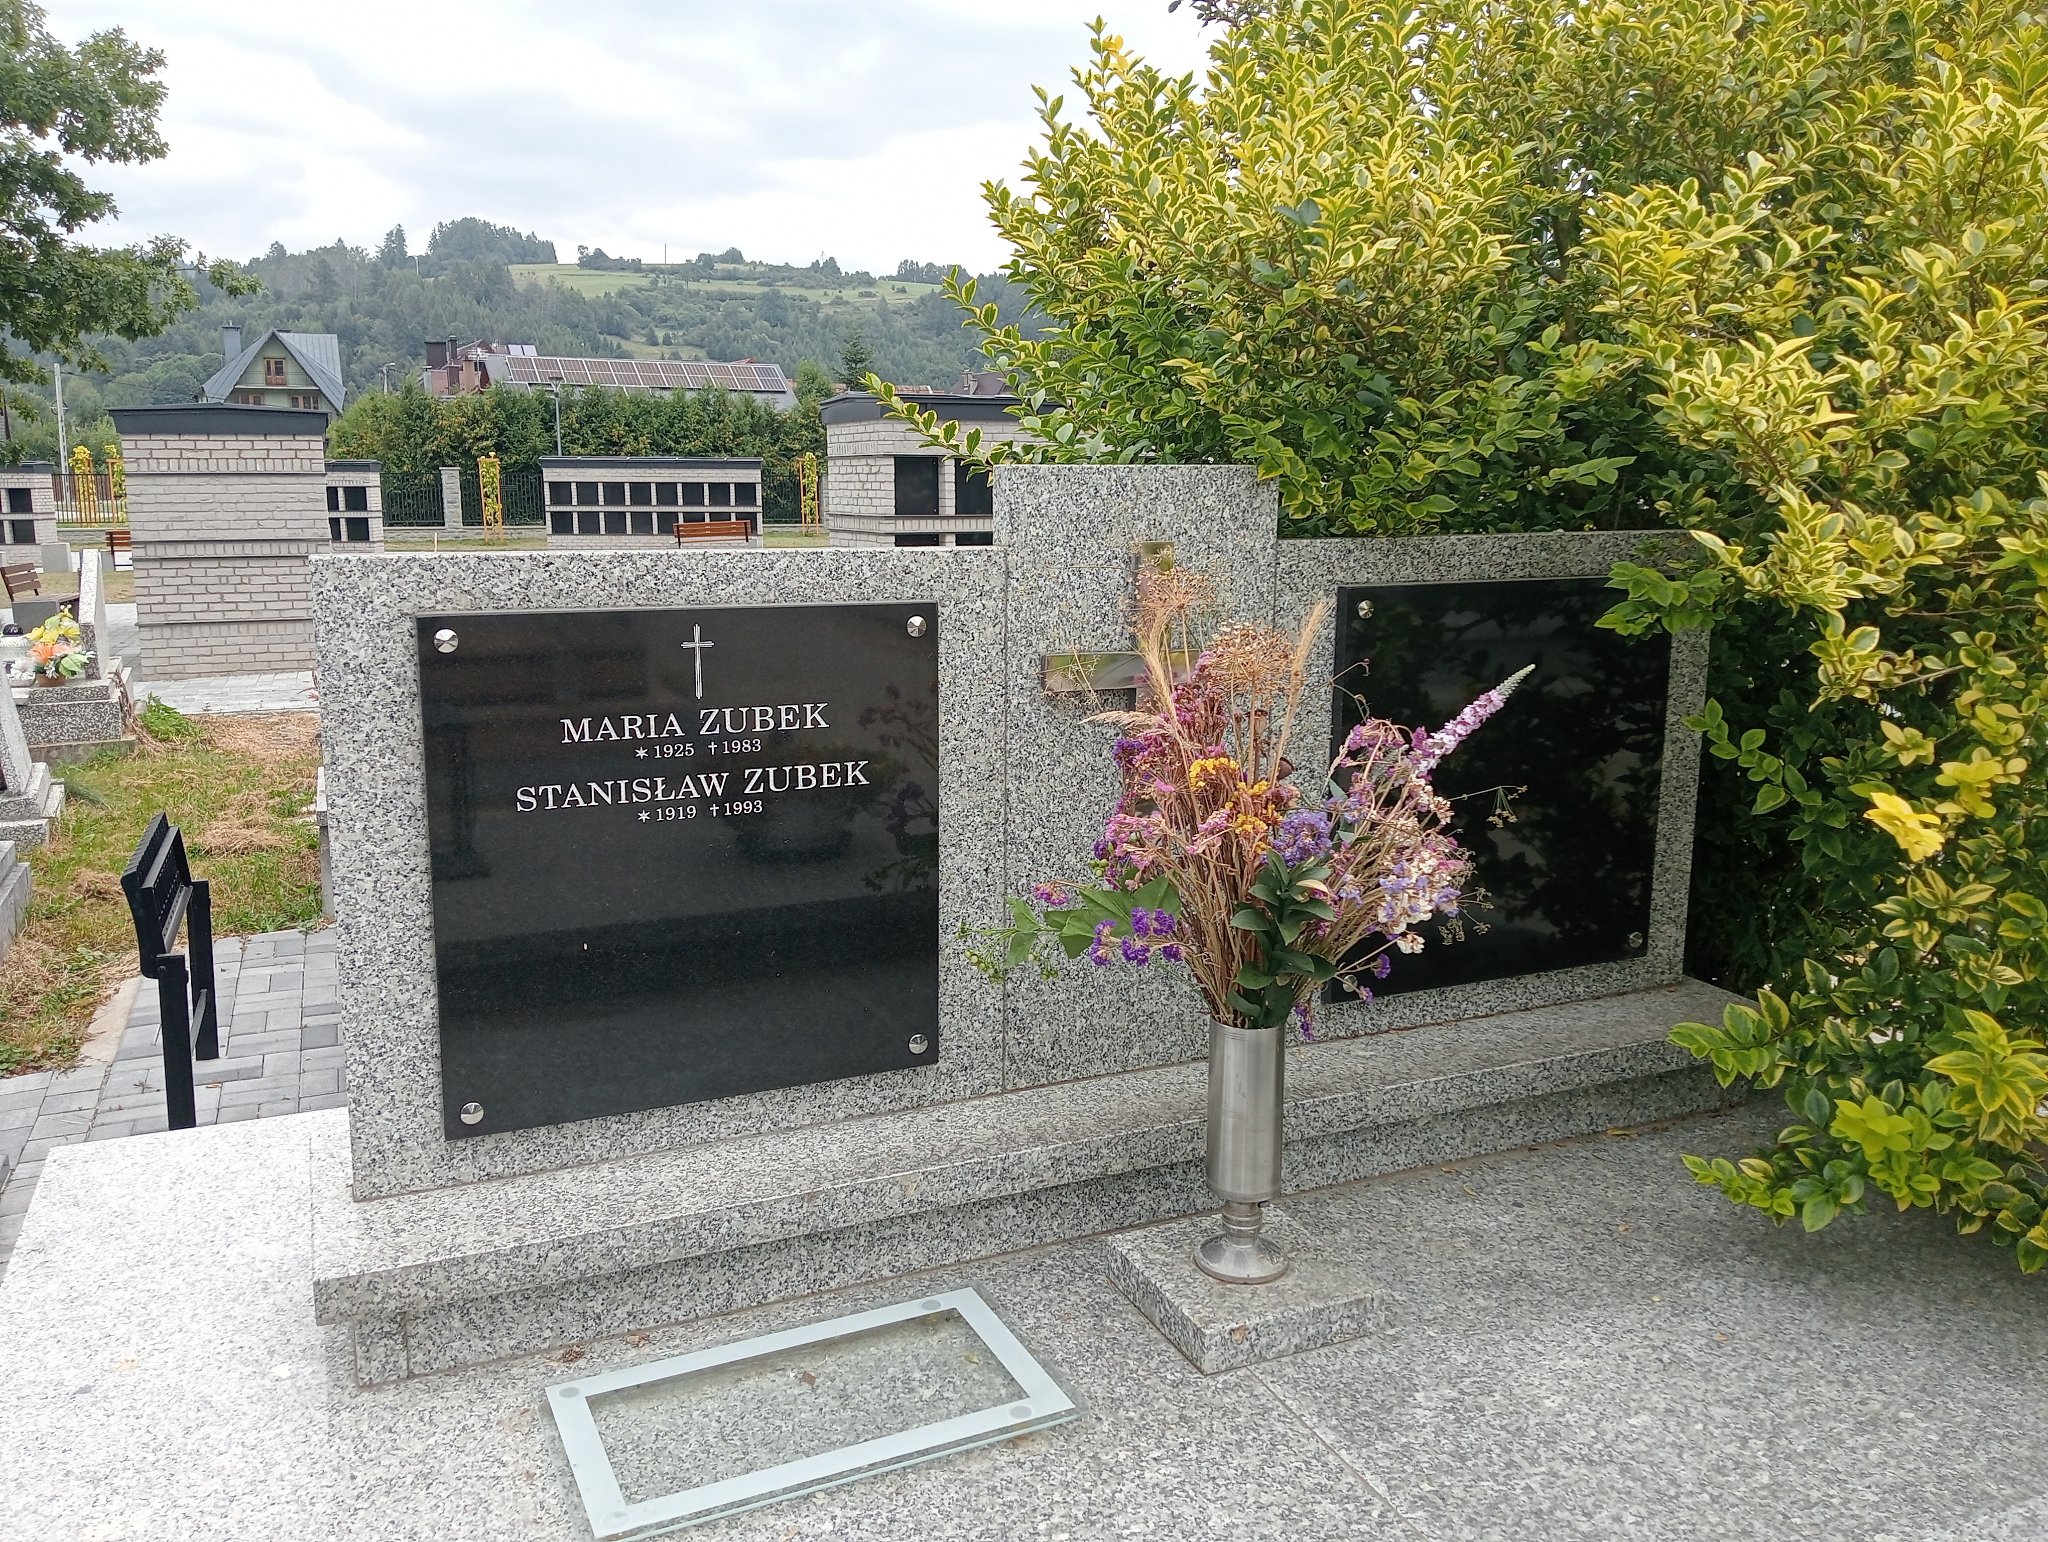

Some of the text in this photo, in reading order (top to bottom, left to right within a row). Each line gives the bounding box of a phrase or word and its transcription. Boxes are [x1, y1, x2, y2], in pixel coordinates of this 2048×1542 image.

[559, 702, 830, 744] MARIA ZUBEK
[516, 760, 871, 812] STANISŁAW ZUBEK
